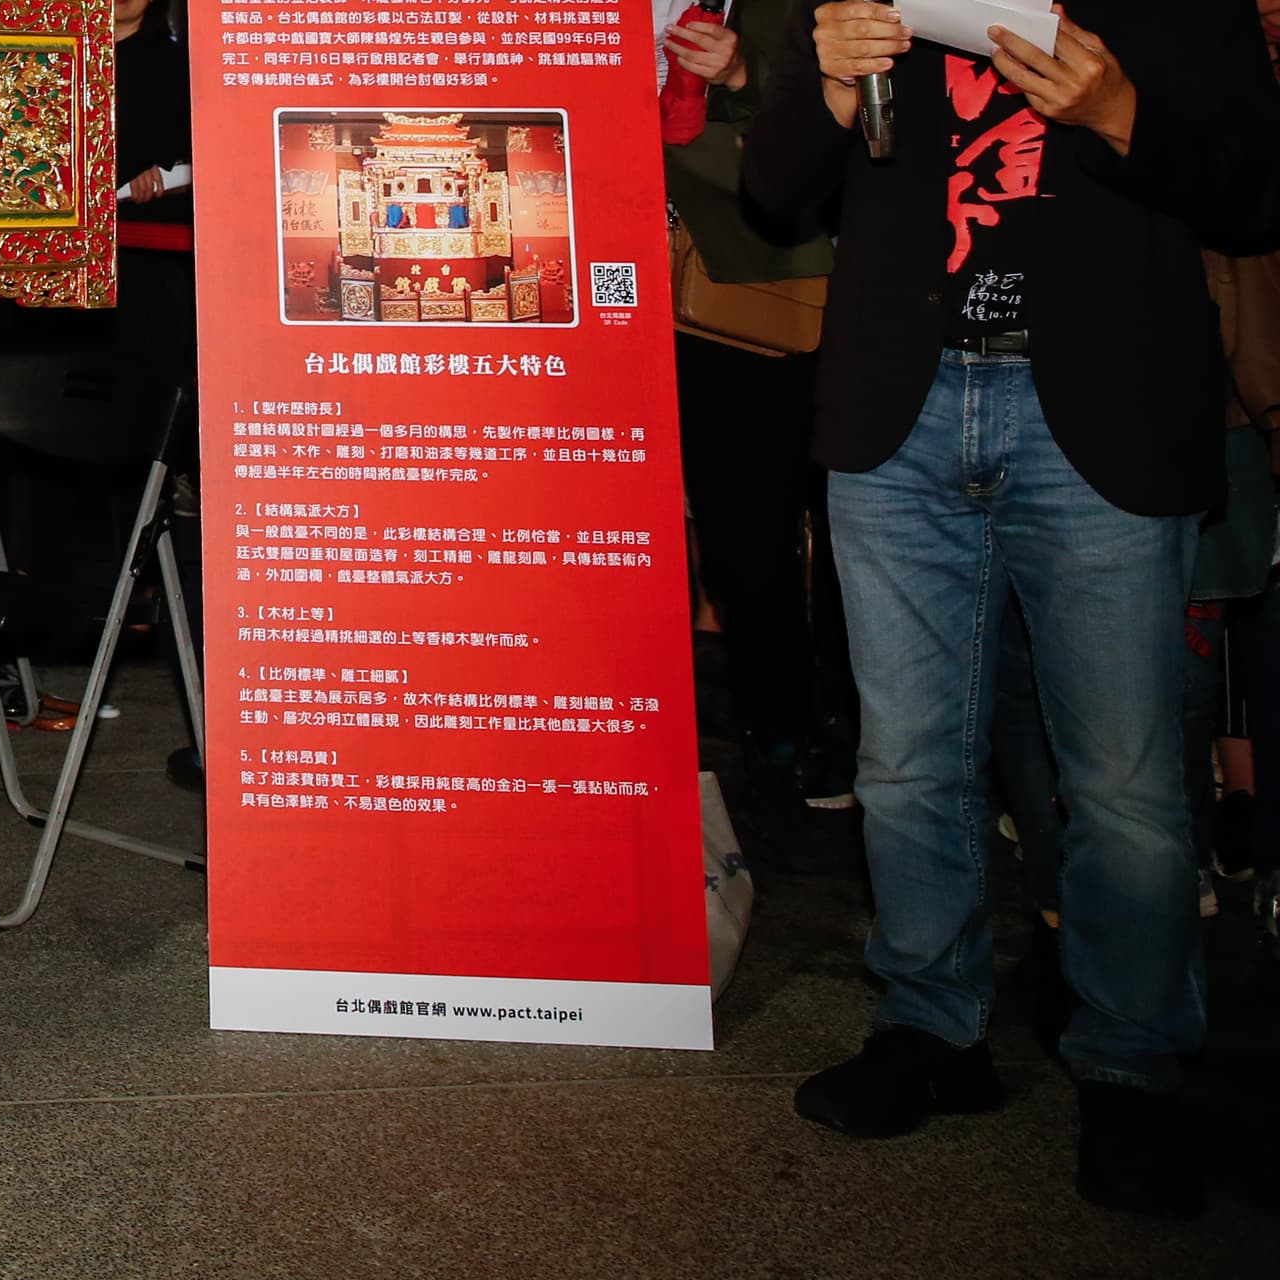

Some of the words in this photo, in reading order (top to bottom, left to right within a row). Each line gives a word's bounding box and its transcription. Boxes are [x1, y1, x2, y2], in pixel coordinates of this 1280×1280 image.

[991, 293, 1022, 305] 2018
[304, 352, 567, 376] 台北偶戲館彩樓五大特色
[238, 627, 539, 647] 所用木材經過精挑細選的上等香樟木製作而成。
[241, 792, 457, 812] 具有色澤鮮亮、不易退色的效果。
[335, 998, 447, 1017] 台北偶戲館官網
[453, 1006, 583, 1023] www.pact.taipei
